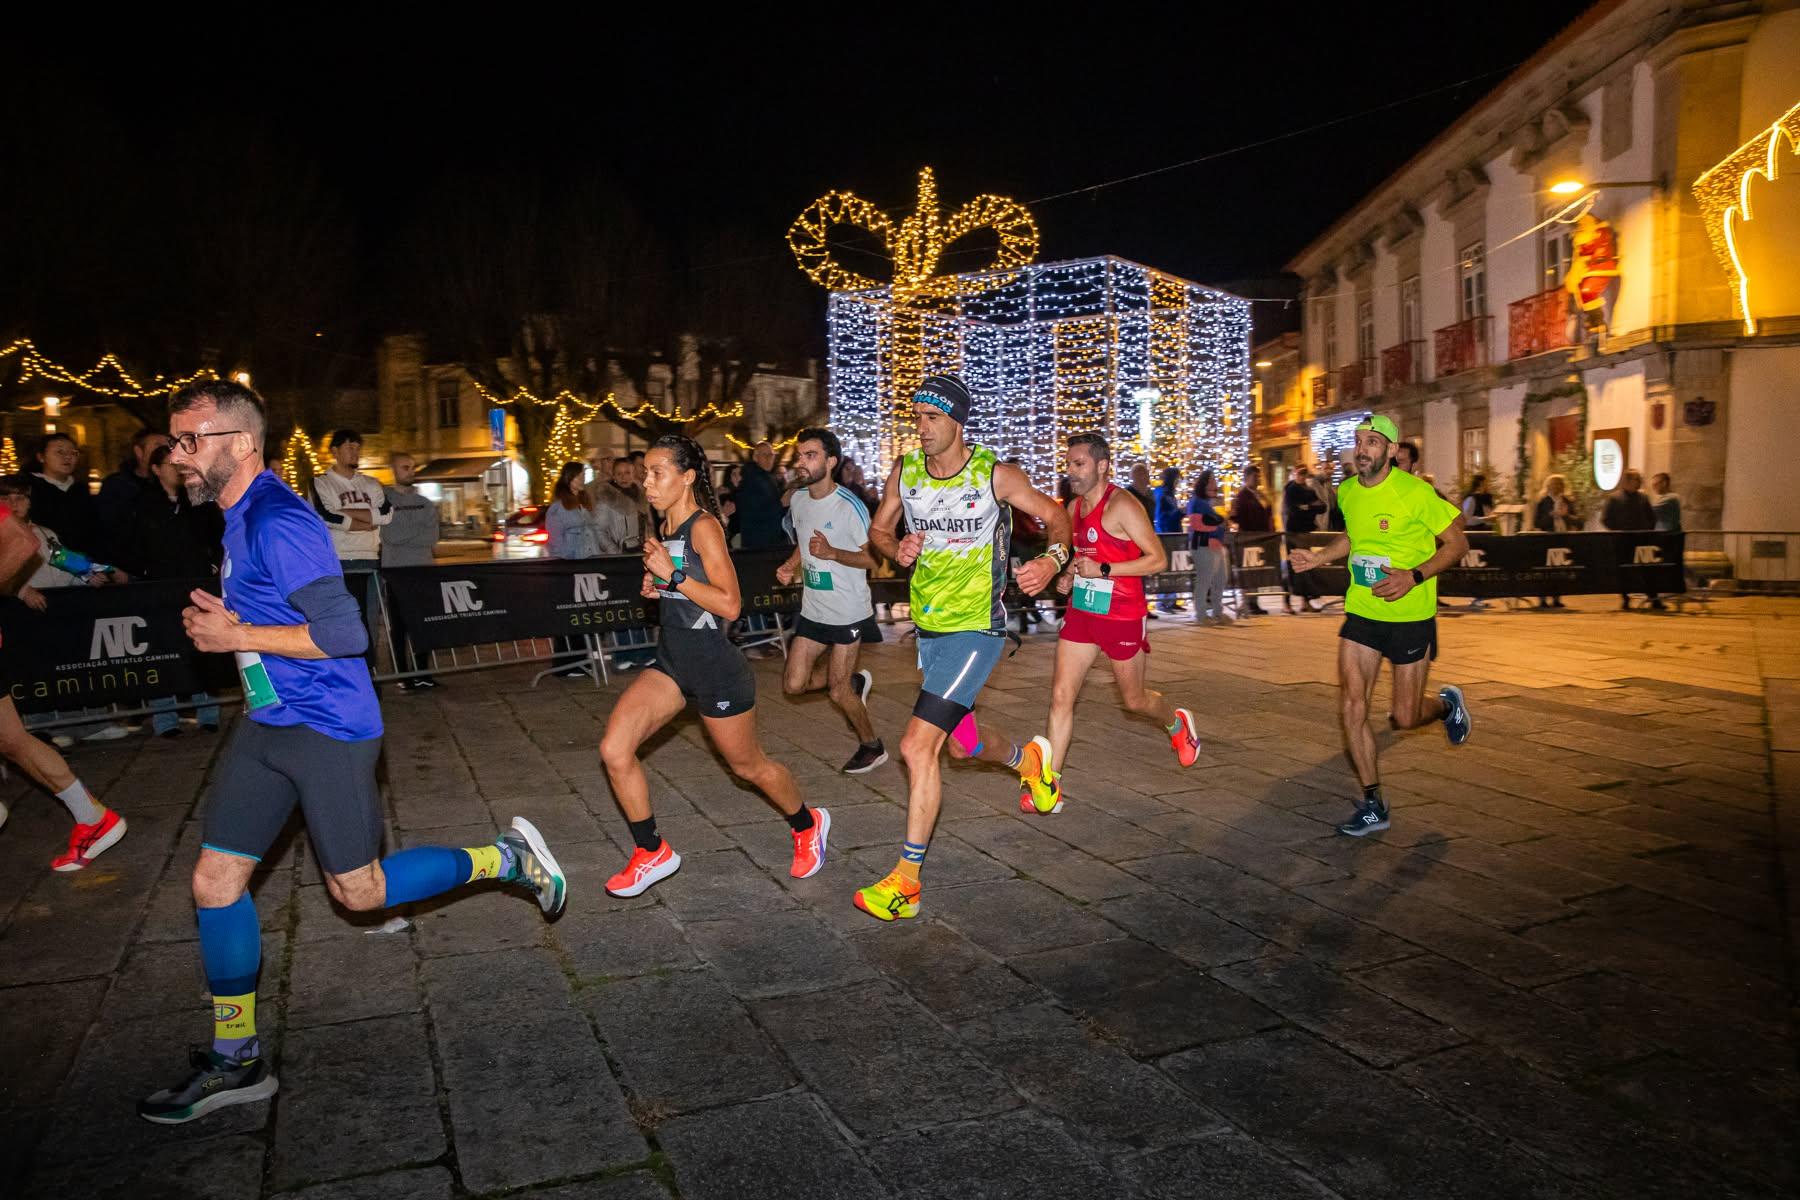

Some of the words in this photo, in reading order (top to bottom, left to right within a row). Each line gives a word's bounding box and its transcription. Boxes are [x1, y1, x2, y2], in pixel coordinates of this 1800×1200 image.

[339, 491, 372, 506] FILA
[912, 517, 984, 533] EDAL'ARTE
[1364, 567, 1377, 580] 49
[1084, 589, 1095, 603] 41
[56, 659, 108, 671] ASSOCIAÇÃO
[145, 653, 181, 662] CAMINHA
[10, 667, 160, 700] caminha
